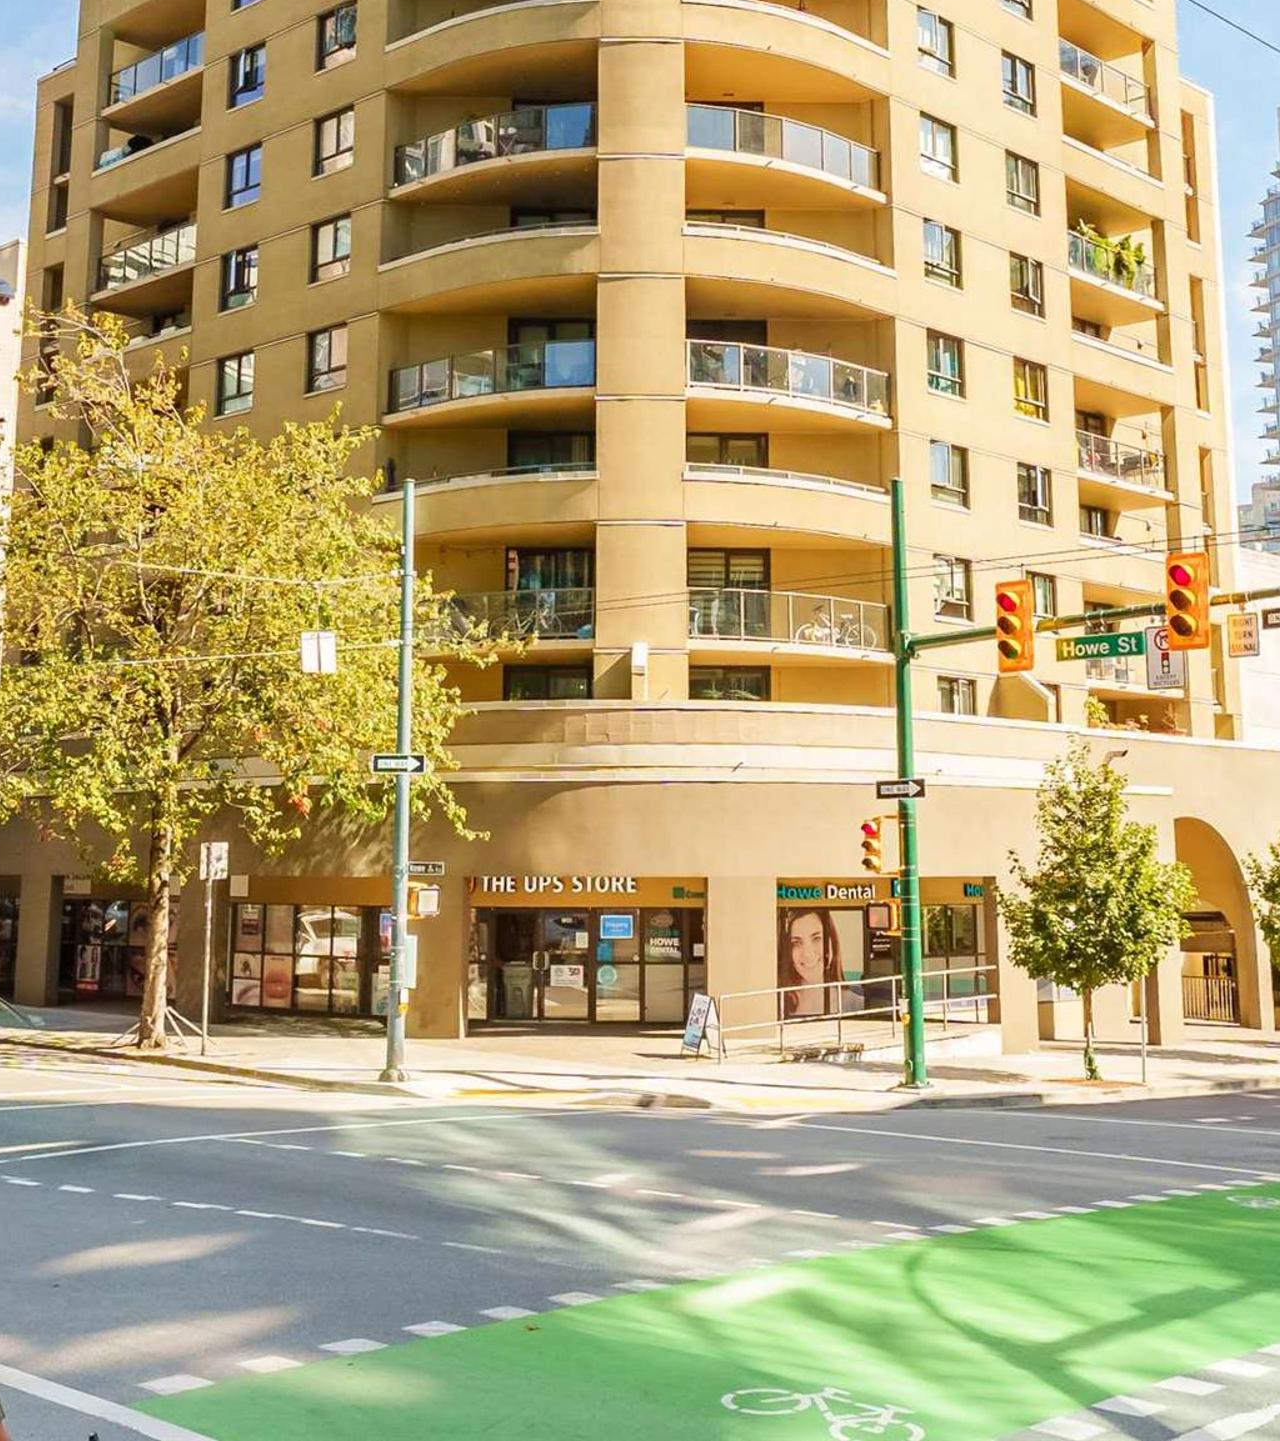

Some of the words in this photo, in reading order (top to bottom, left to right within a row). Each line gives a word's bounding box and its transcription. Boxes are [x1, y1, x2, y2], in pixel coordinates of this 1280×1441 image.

[1062, 641, 1111, 657] Howe
[1118, 637, 1138, 652] St
[481, 876, 516, 893] THE
[523, 876, 564, 893] UPS
[572, 876, 637, 893] STORE
[777, 885, 823, 899] Howe
[827, 884, 876, 899] Dental
[650, 938, 680, 946] HOWE
